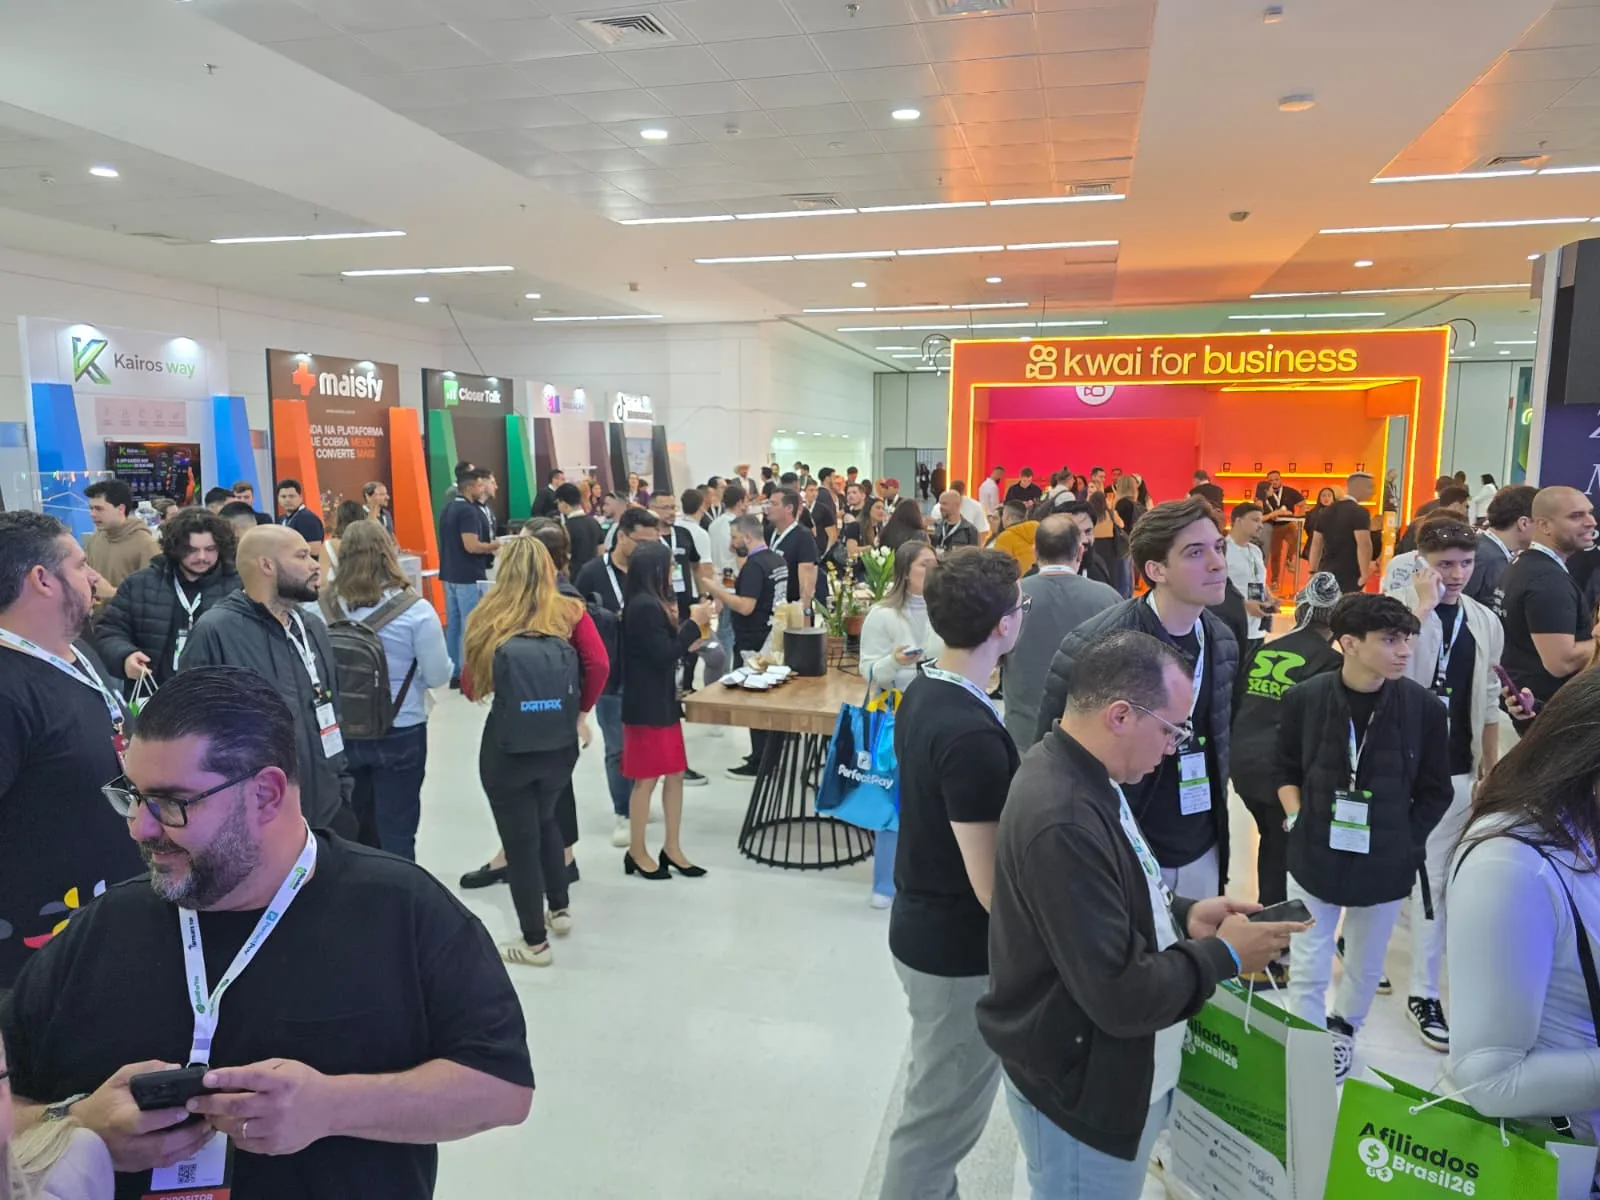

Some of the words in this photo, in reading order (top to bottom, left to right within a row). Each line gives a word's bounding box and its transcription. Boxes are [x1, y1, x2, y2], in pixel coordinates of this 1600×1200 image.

[114, 353, 163, 372] Kairos
[166, 361, 195, 379] way
[1064, 347, 1142, 376] kwai
[1150, 346, 1196, 375] for
[1204, 344, 1357, 374] business
[319, 368, 383, 402] maisfy
[323, 437, 349, 447] COBRA
[337, 425, 384, 437] PLATAFORMA
[316, 448, 356, 459] CONVERTE
[1359, 1122, 1480, 1179] Afiliados
[1392, 1154, 1476, 1197] Brasil26
